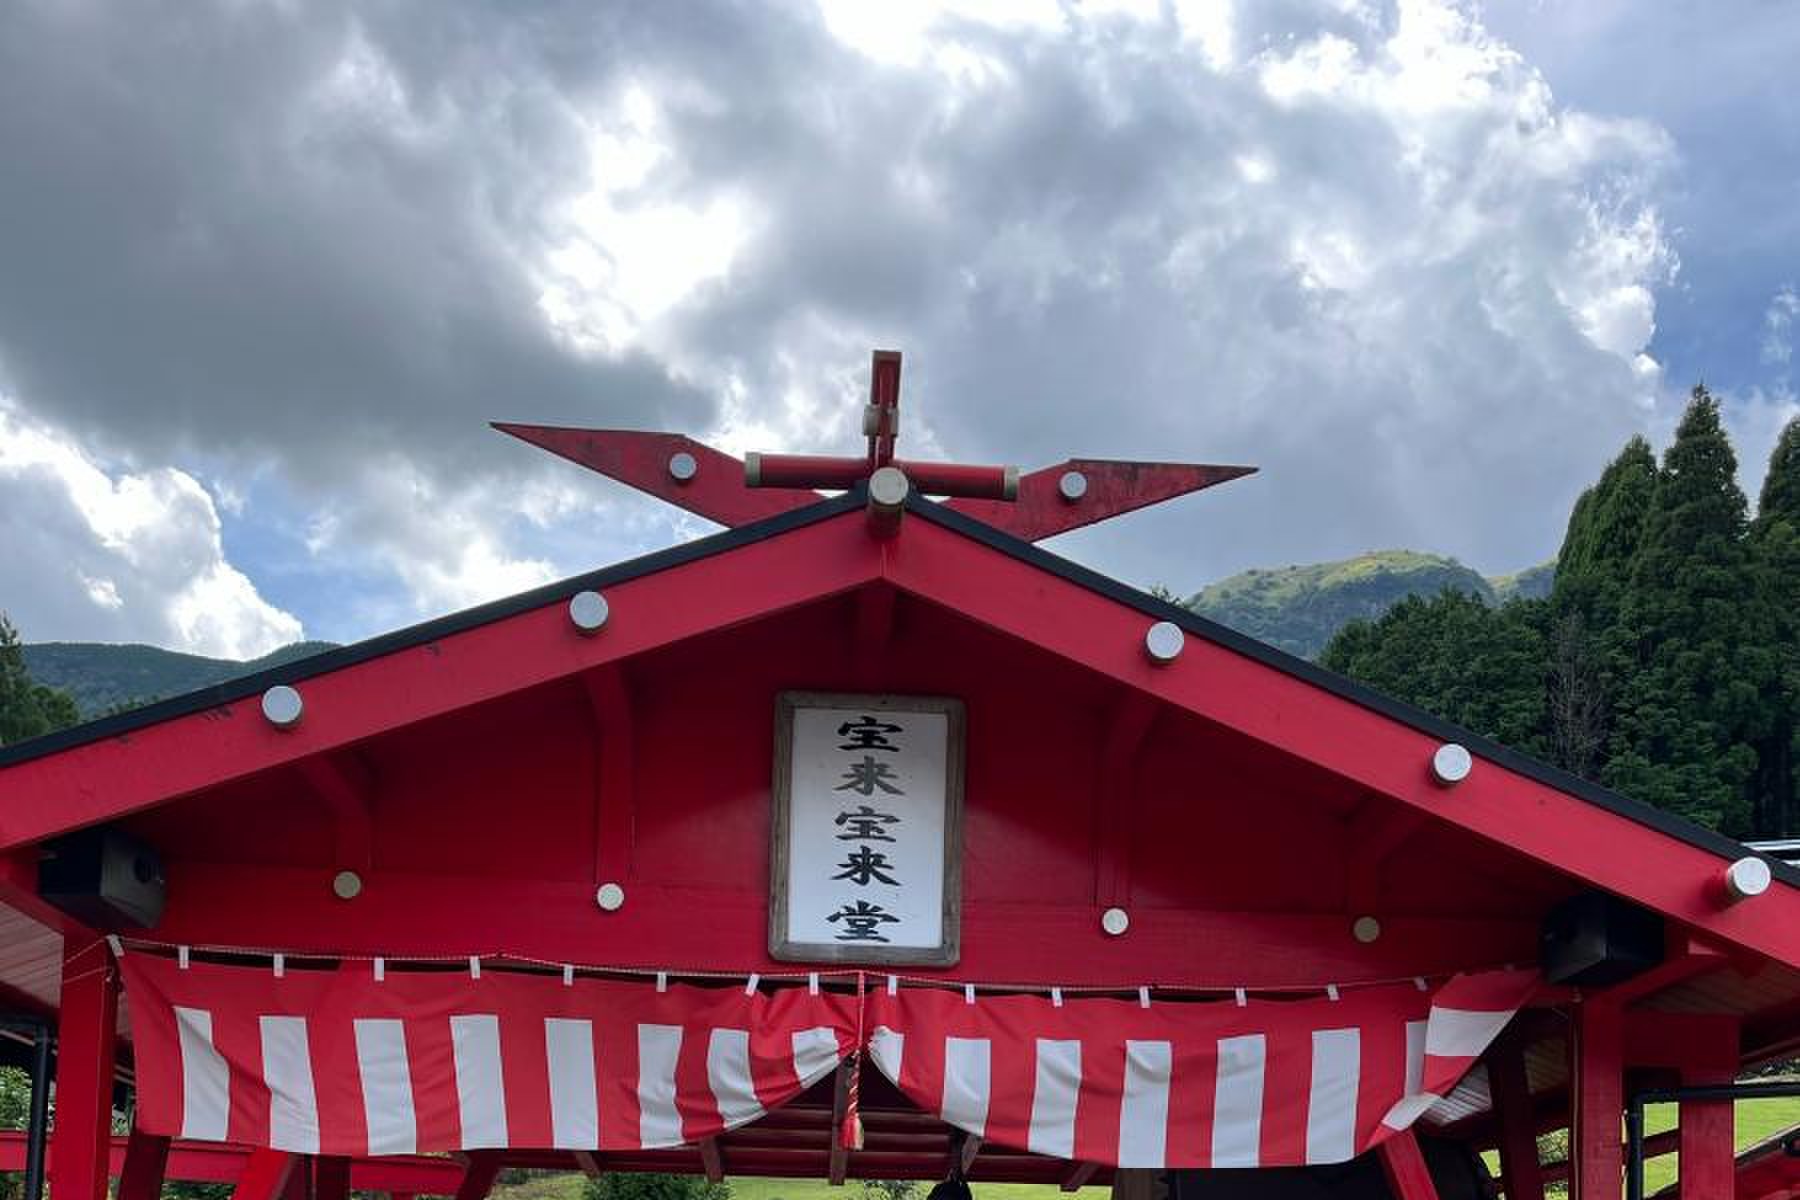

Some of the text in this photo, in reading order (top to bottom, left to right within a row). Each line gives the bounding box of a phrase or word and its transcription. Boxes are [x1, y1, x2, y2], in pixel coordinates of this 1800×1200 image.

[826, 716, 905, 942] 宝来宝来堂
